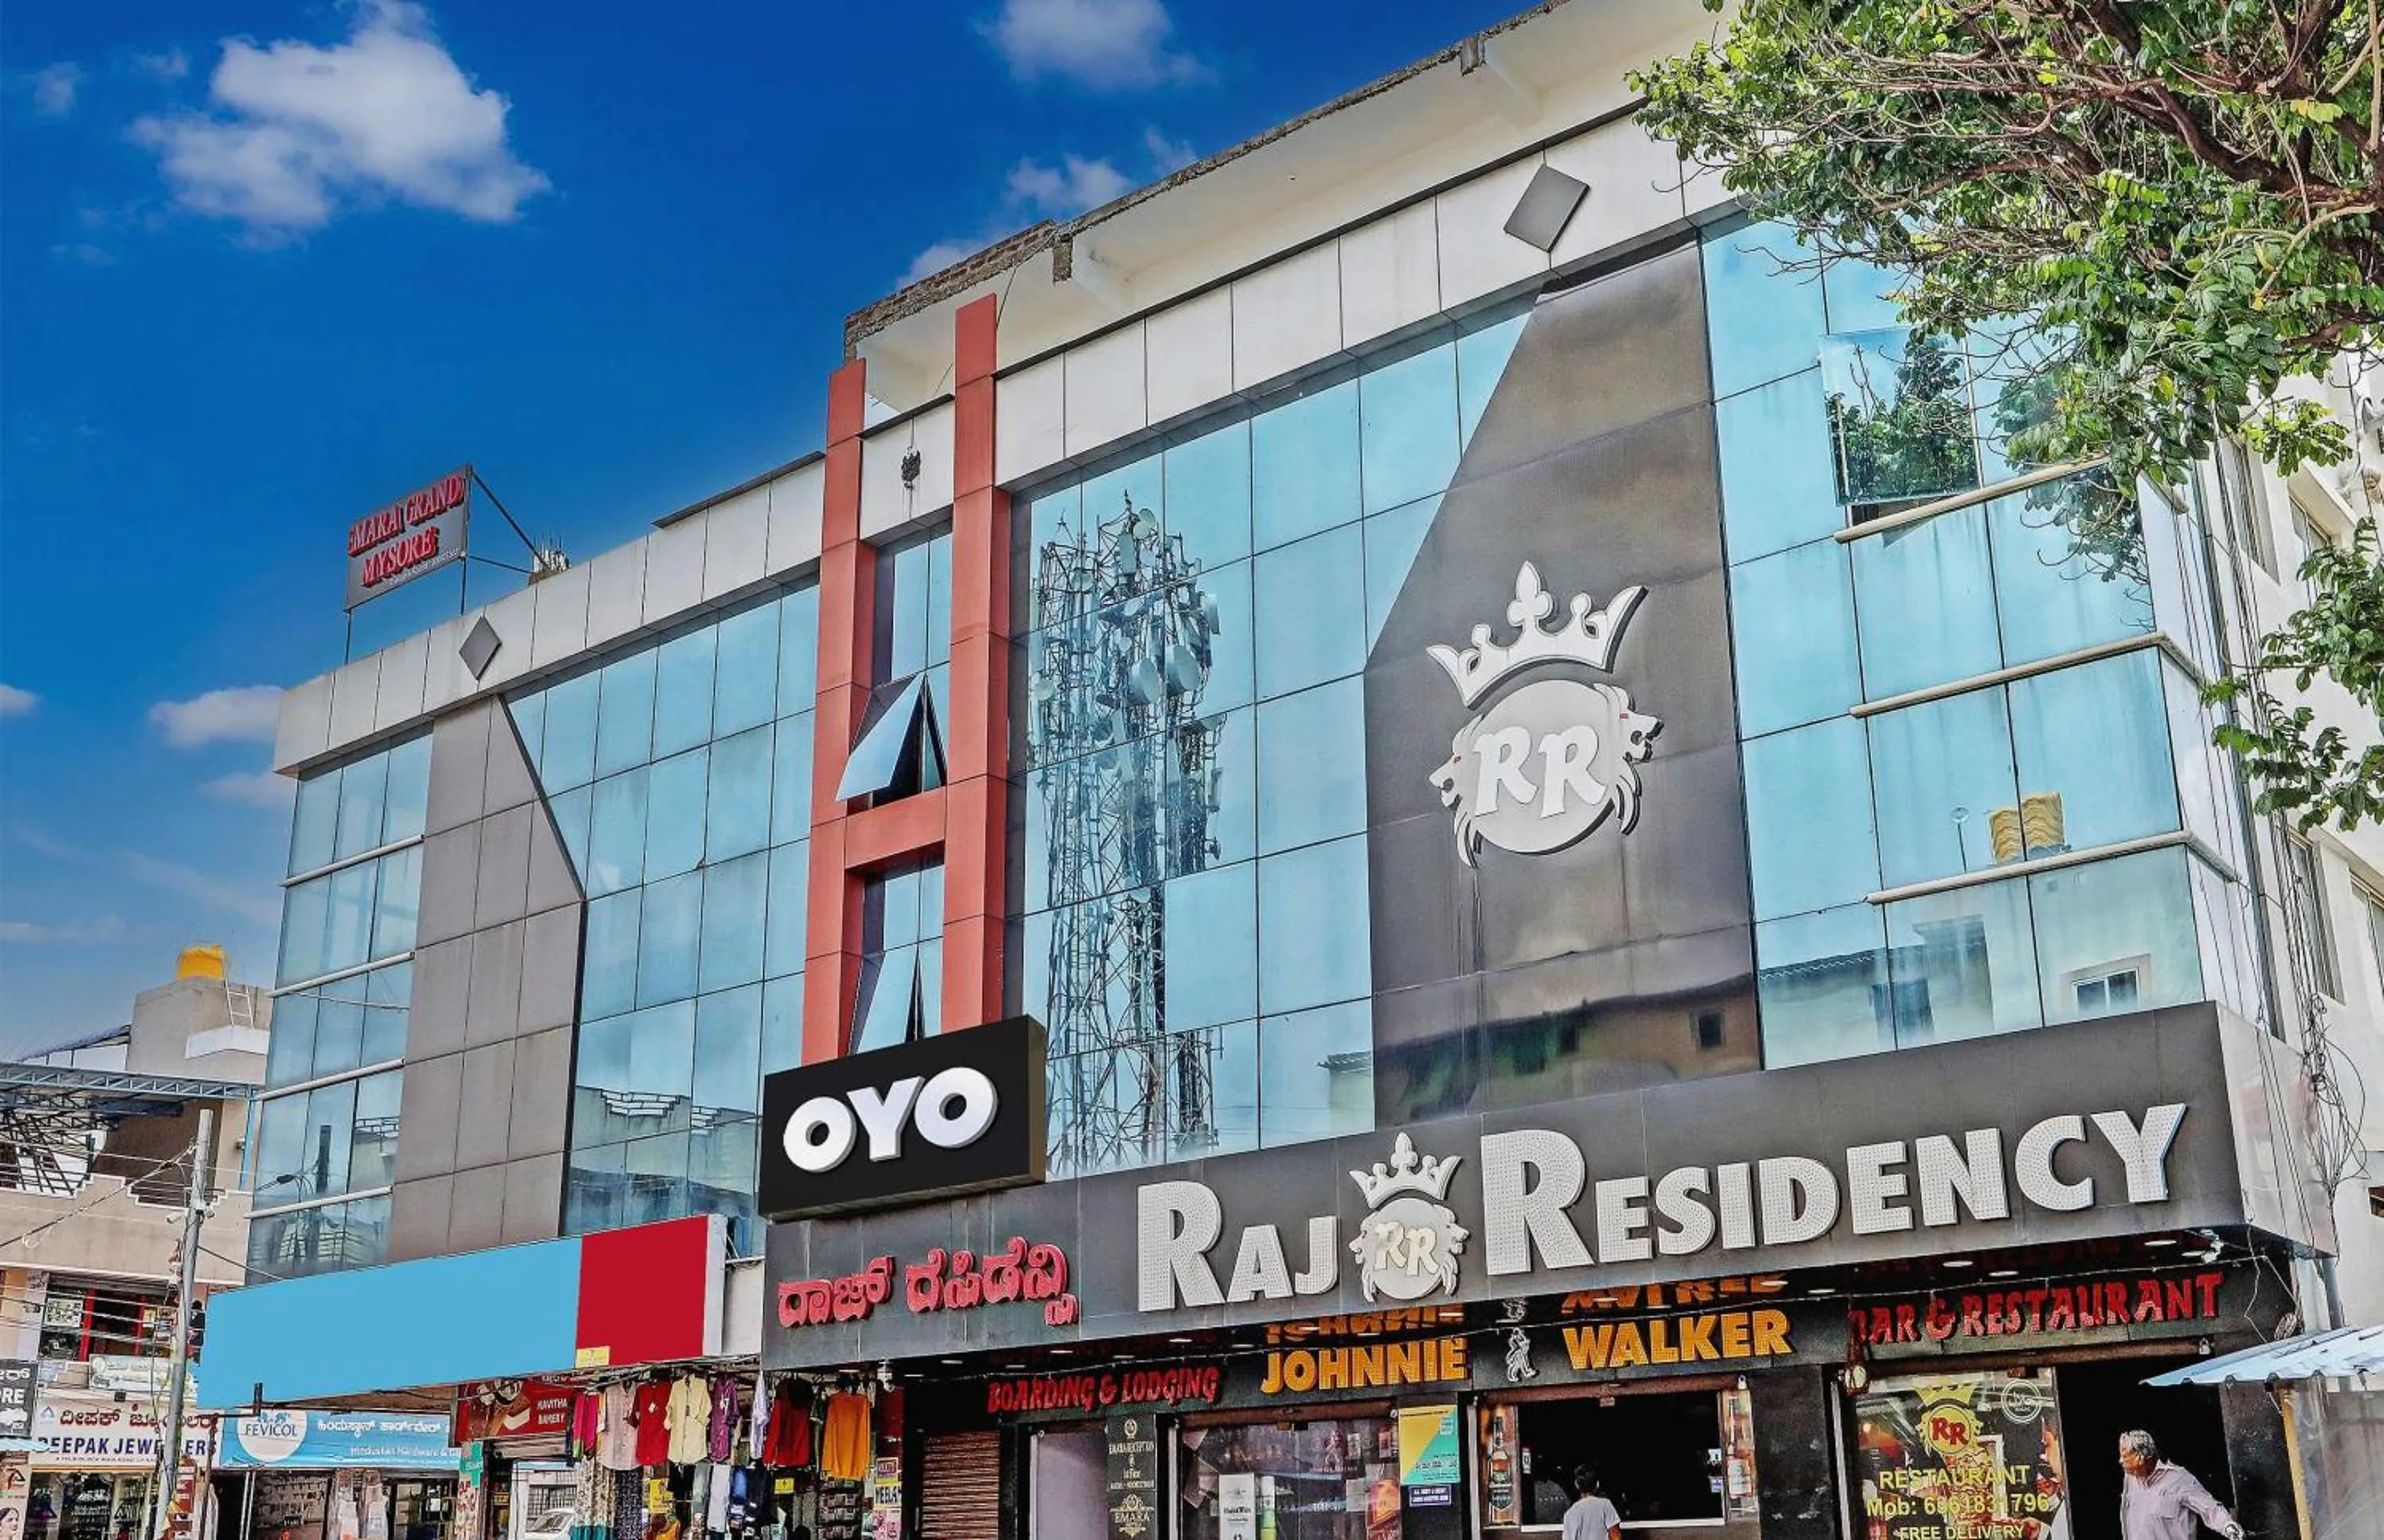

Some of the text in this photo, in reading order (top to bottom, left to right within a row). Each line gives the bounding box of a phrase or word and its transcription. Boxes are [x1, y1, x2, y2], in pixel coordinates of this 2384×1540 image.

[405, 475, 464, 524] GRAND
[362, 525, 439, 586] MYSORE
[1473, 725, 1608, 818] RR
[783, 1066, 998, 1173] OYO
[1480, 1102, 2187, 1276] RESIDENCY
[1137, 1179, 1338, 1312] RAJ
[1373, 1221, 1439, 1277] RR
[777, 1255, 894, 1328] ರಾಜ್
[1925, 1295, 1956, 1340] &
[1962, 1271, 2223, 1337] RESTAURANT
[1260, 1337, 1467, 1393] JOHNNIE
[1562, 1309, 1793, 1371] WALKER
[0, 1387, 25, 1405] RE
[987, 1365, 1220, 1413] BOARDING & LODGING
[246, 1423, 297, 1437] FEVICOL
[1931, 1417, 1968, 1445] RR
[1879, 1465, 2030, 1489] RESTAURANT
[1867, 1496, 1917, 1517] Mob:
[1900, 1524, 2024, 1540] FREE DELIVERY
